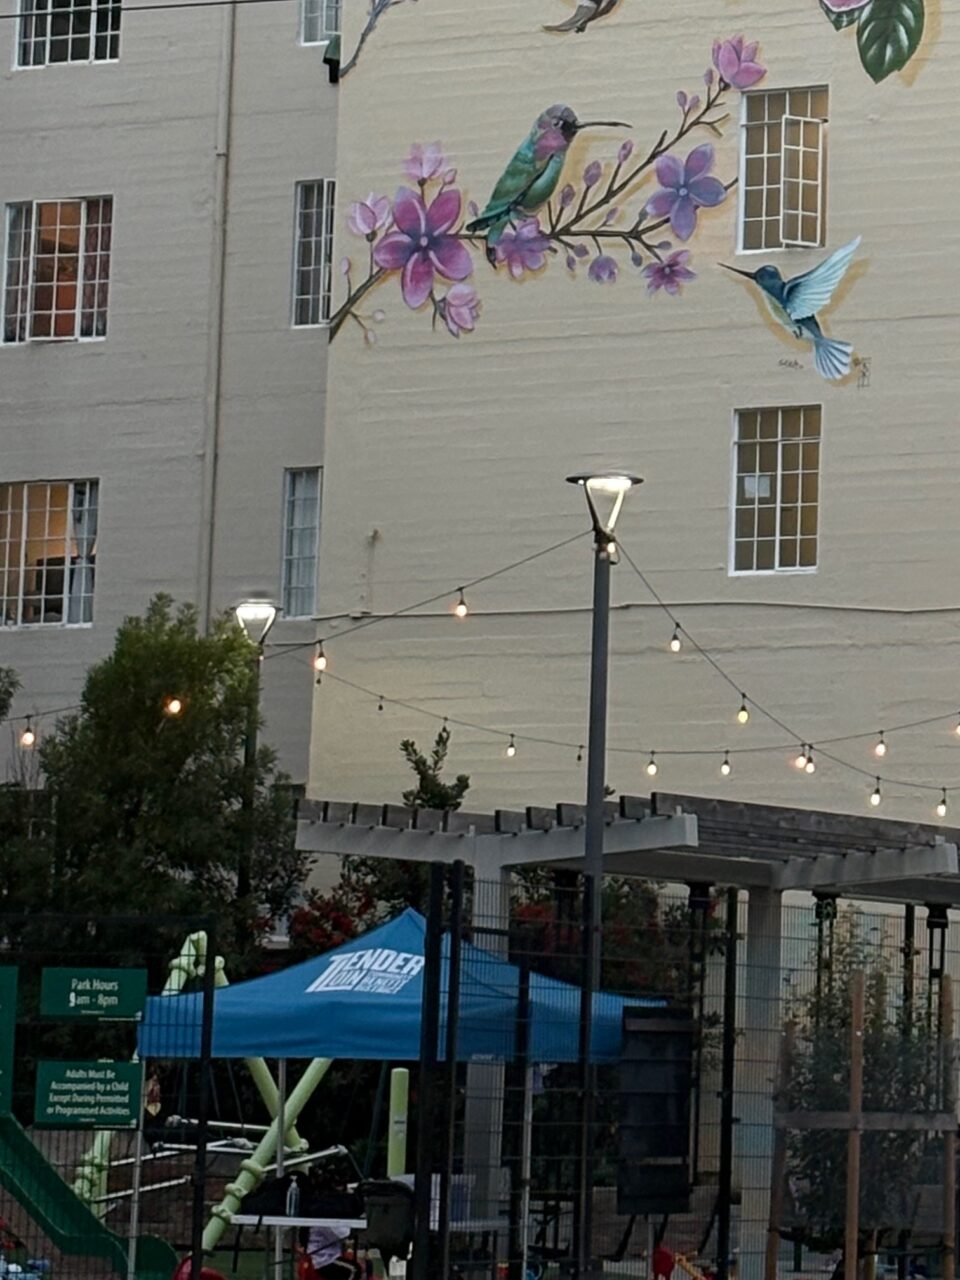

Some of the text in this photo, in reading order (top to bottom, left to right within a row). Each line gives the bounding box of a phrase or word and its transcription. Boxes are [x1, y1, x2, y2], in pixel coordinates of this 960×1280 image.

[71, 978, 119, 991] Park Hours
[97, 994, 119, 1007] 8pm
